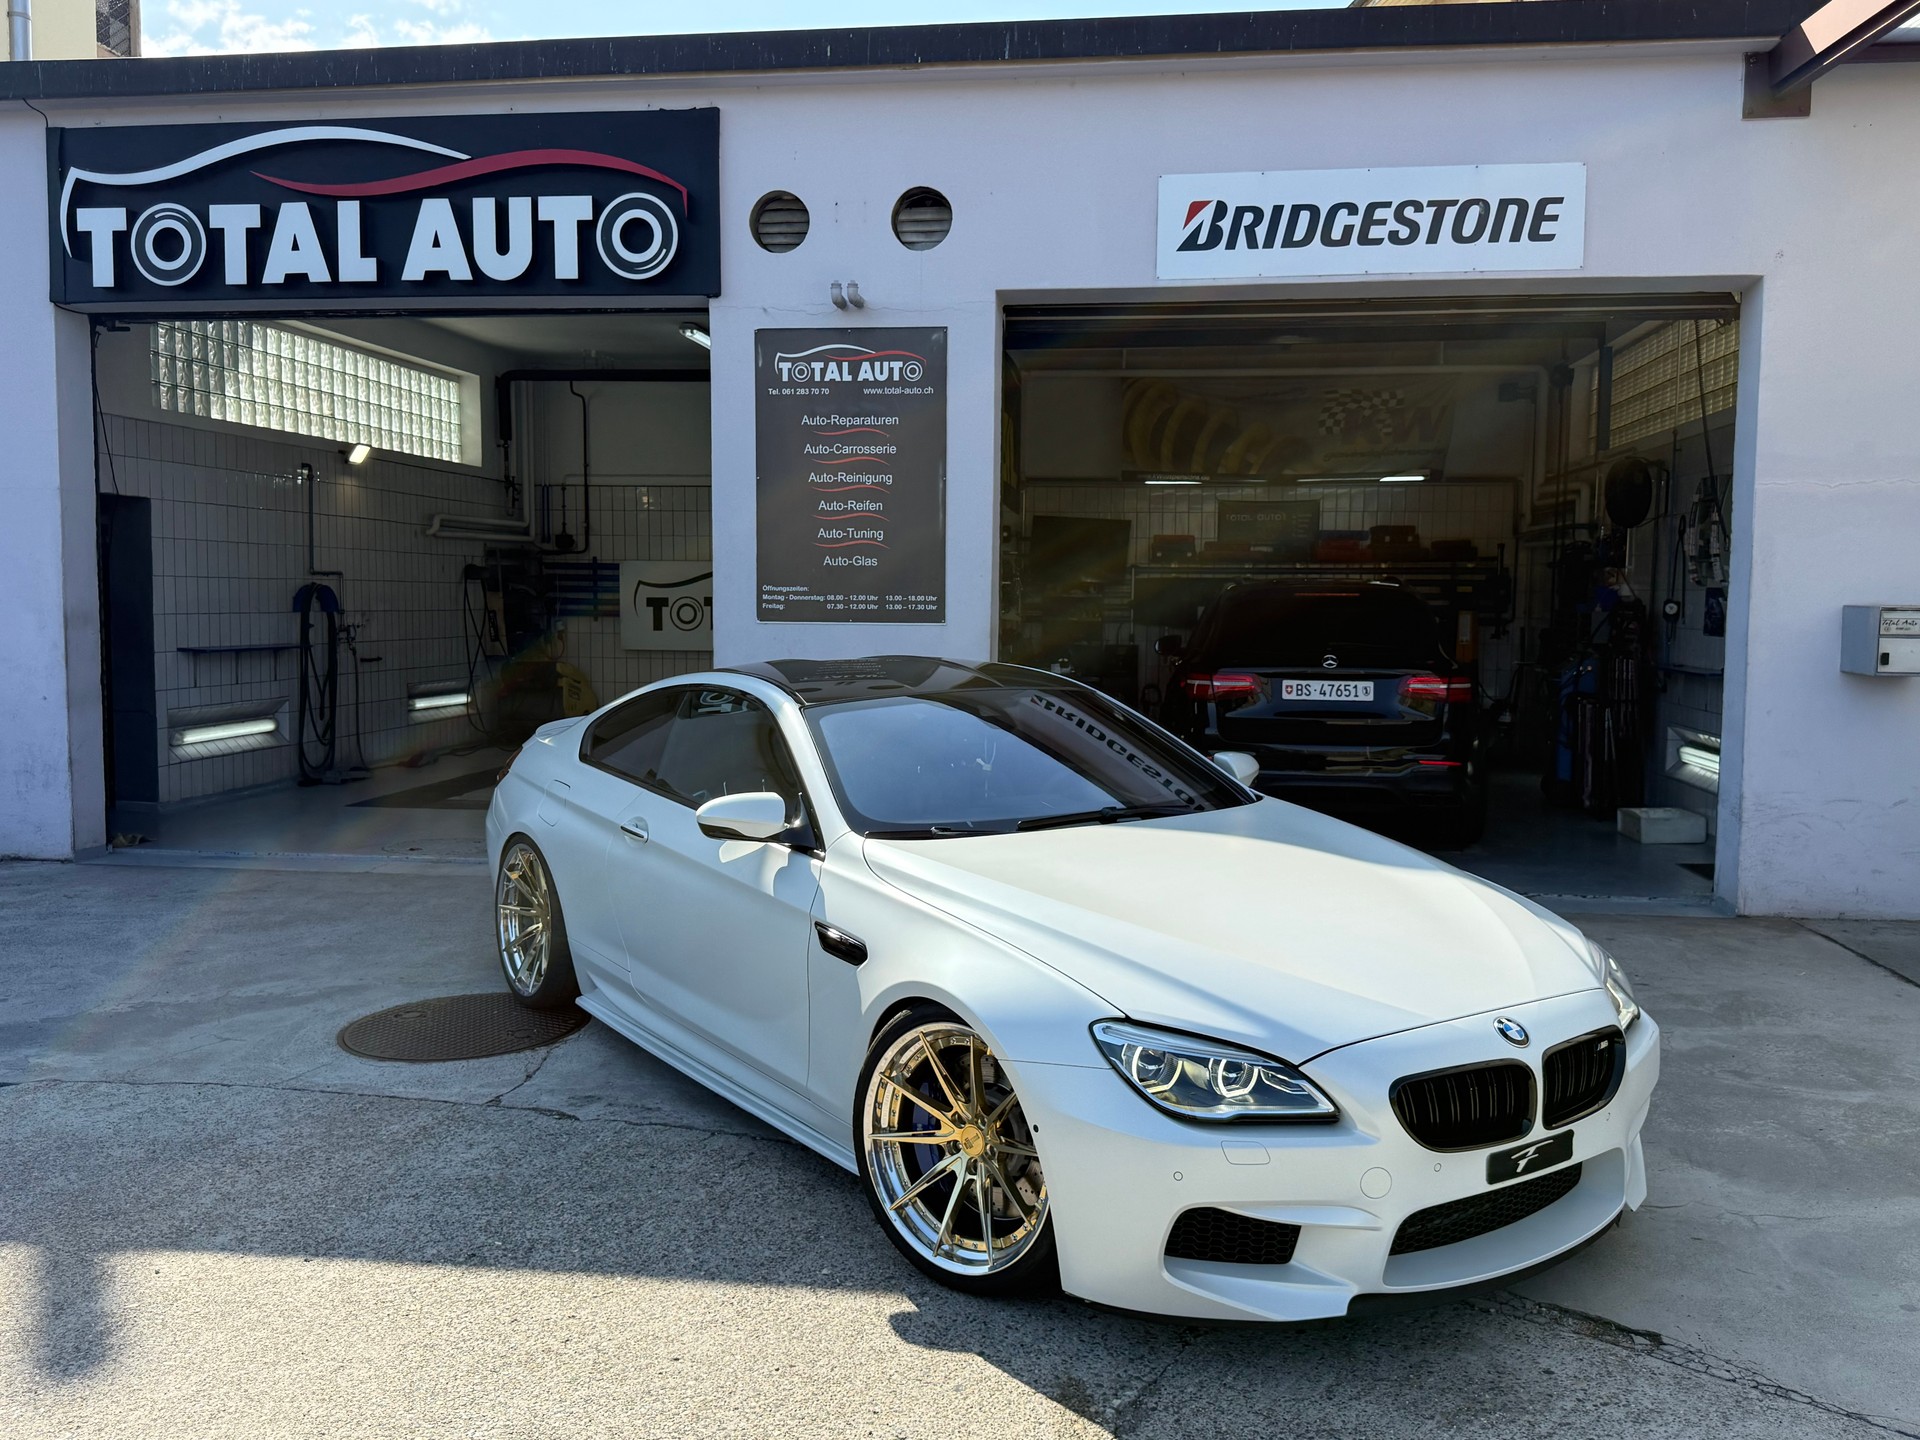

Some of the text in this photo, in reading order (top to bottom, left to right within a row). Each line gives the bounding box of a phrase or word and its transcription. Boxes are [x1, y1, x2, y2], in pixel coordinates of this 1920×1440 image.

[1175, 196, 1565, 252] BRIDGESTONE
[76, 191, 679, 288] TOTAL AUTO
[778, 360, 923, 383] TOTAL AUTO
[863, 386, 934, 396] www.total-auto.ch
[801, 414, 899, 428] Auto-Reparaturen
[804, 443, 897, 455] Auto-Carrosserie
[808, 472, 893, 485] Auto-Reinigung
[818, 500, 883, 511] Auto-Reifen
[817, 528, 884, 541] Auto-Tuning
[823, 555, 878, 567] Auto-Glas
